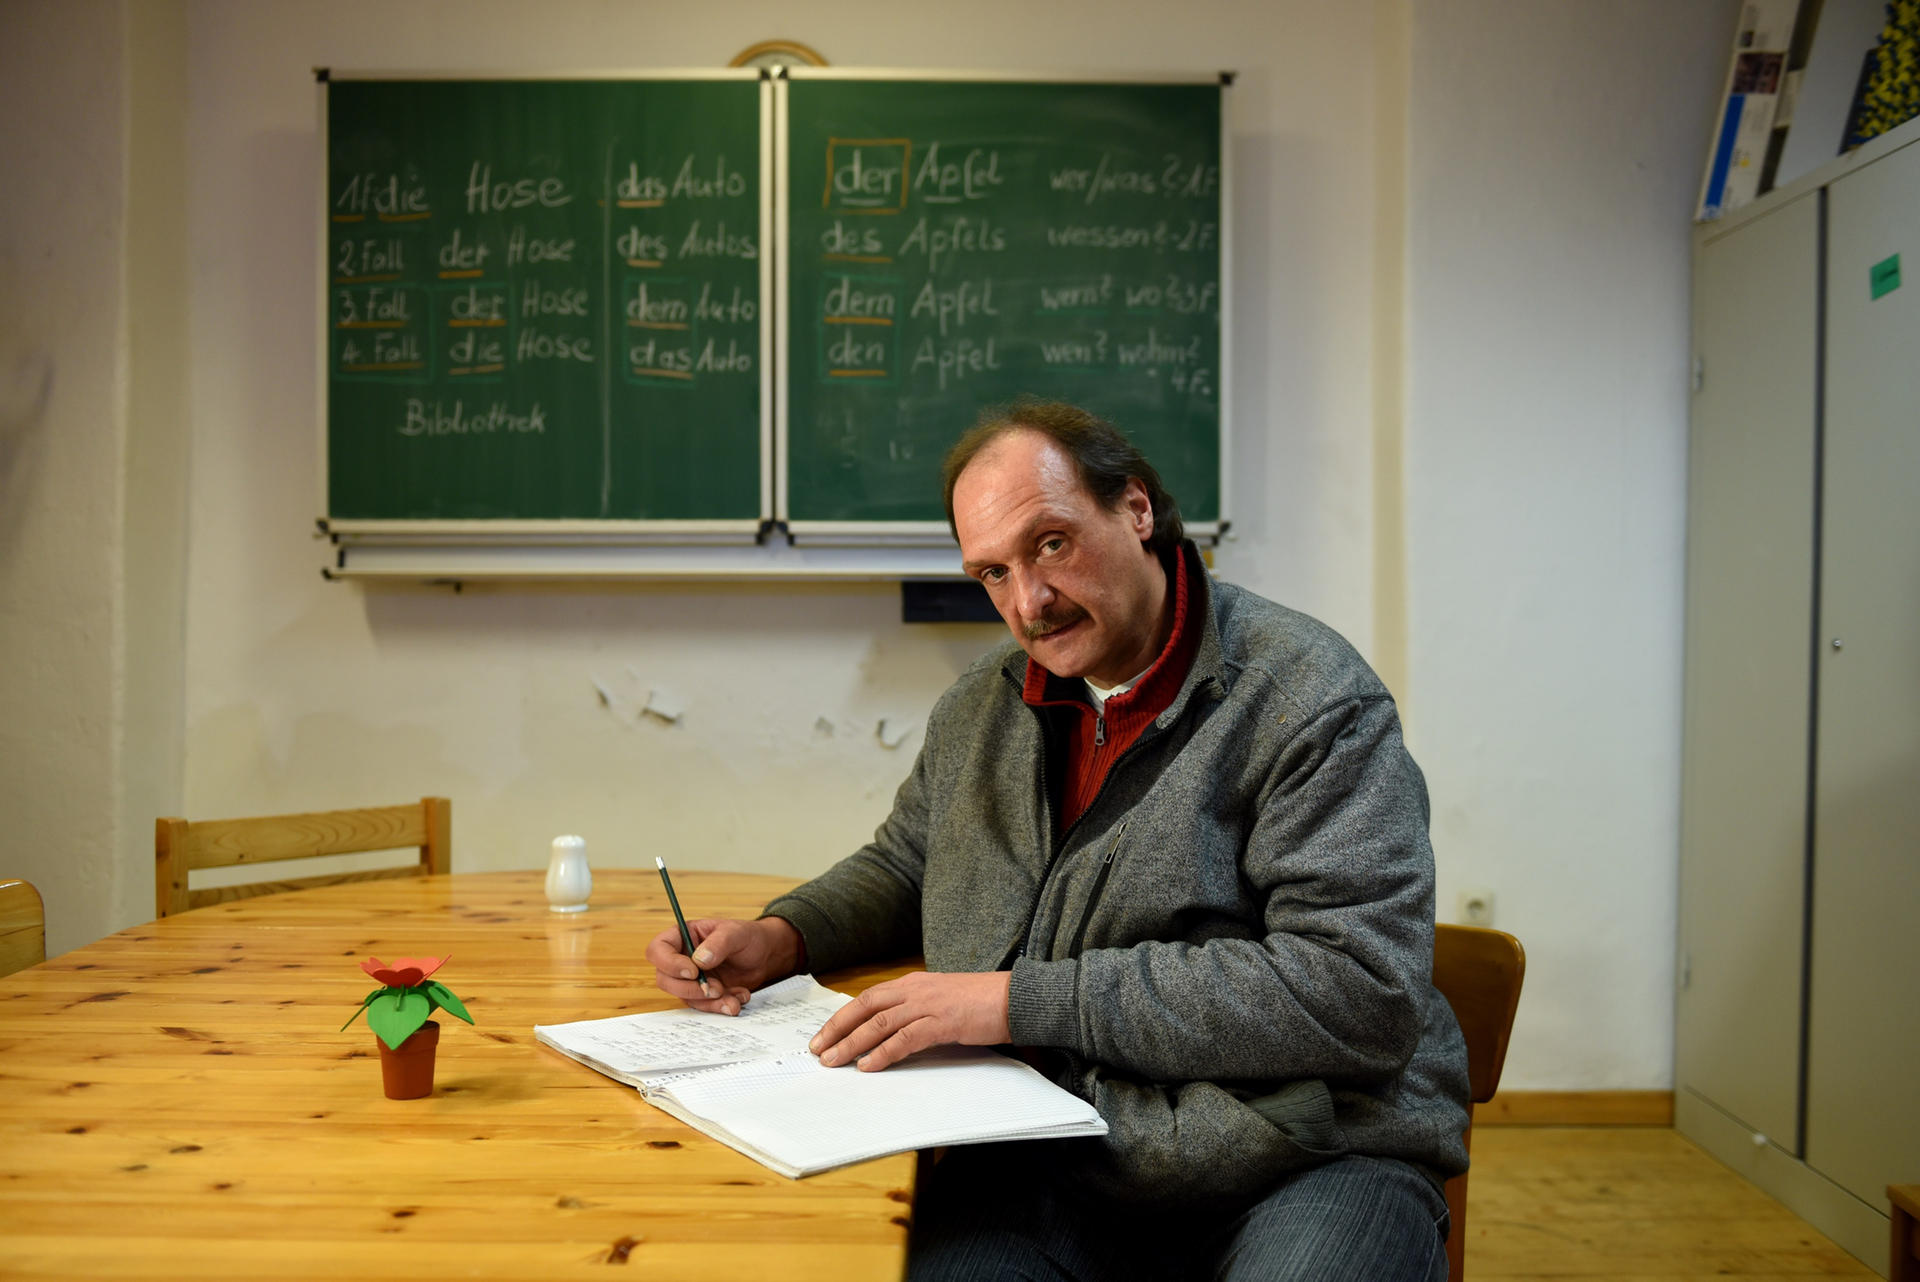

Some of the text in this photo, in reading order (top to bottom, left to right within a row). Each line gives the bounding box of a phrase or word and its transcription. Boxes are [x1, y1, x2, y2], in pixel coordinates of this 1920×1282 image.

[375, 172, 430, 213] die
[466, 161, 573, 213] Hose
[617, 161, 668, 199] das
[672, 153, 746, 198] Auto
[834, 149, 899, 194] der
[914, 141, 1004, 200] Apfel
[361, 238, 404, 273] Fall
[439, 227, 490, 268] der
[507, 224, 576, 268] Hose
[617, 224, 668, 259] des
[821, 218, 884, 254] des
[898, 216, 1007, 271] Apfels
[366, 287, 411, 321] Fall
[451, 285, 505, 322] der
[521, 279, 589, 318] Hose
[627, 281, 689, 321] dem
[694, 281, 757, 323] Auto
[825, 275, 895, 317] dem
[911, 276, 1000, 336] Apfel
[374, 331, 421, 363] Fall
[449, 329, 505, 364] die
[516, 328, 595, 363] Hose
[630, 338, 693, 372] das
[696, 336, 752, 372] Auto
[828, 329, 886, 365] den
[911, 335, 1001, 391] Apfel
[398, 397, 547, 437] Bibliothek
